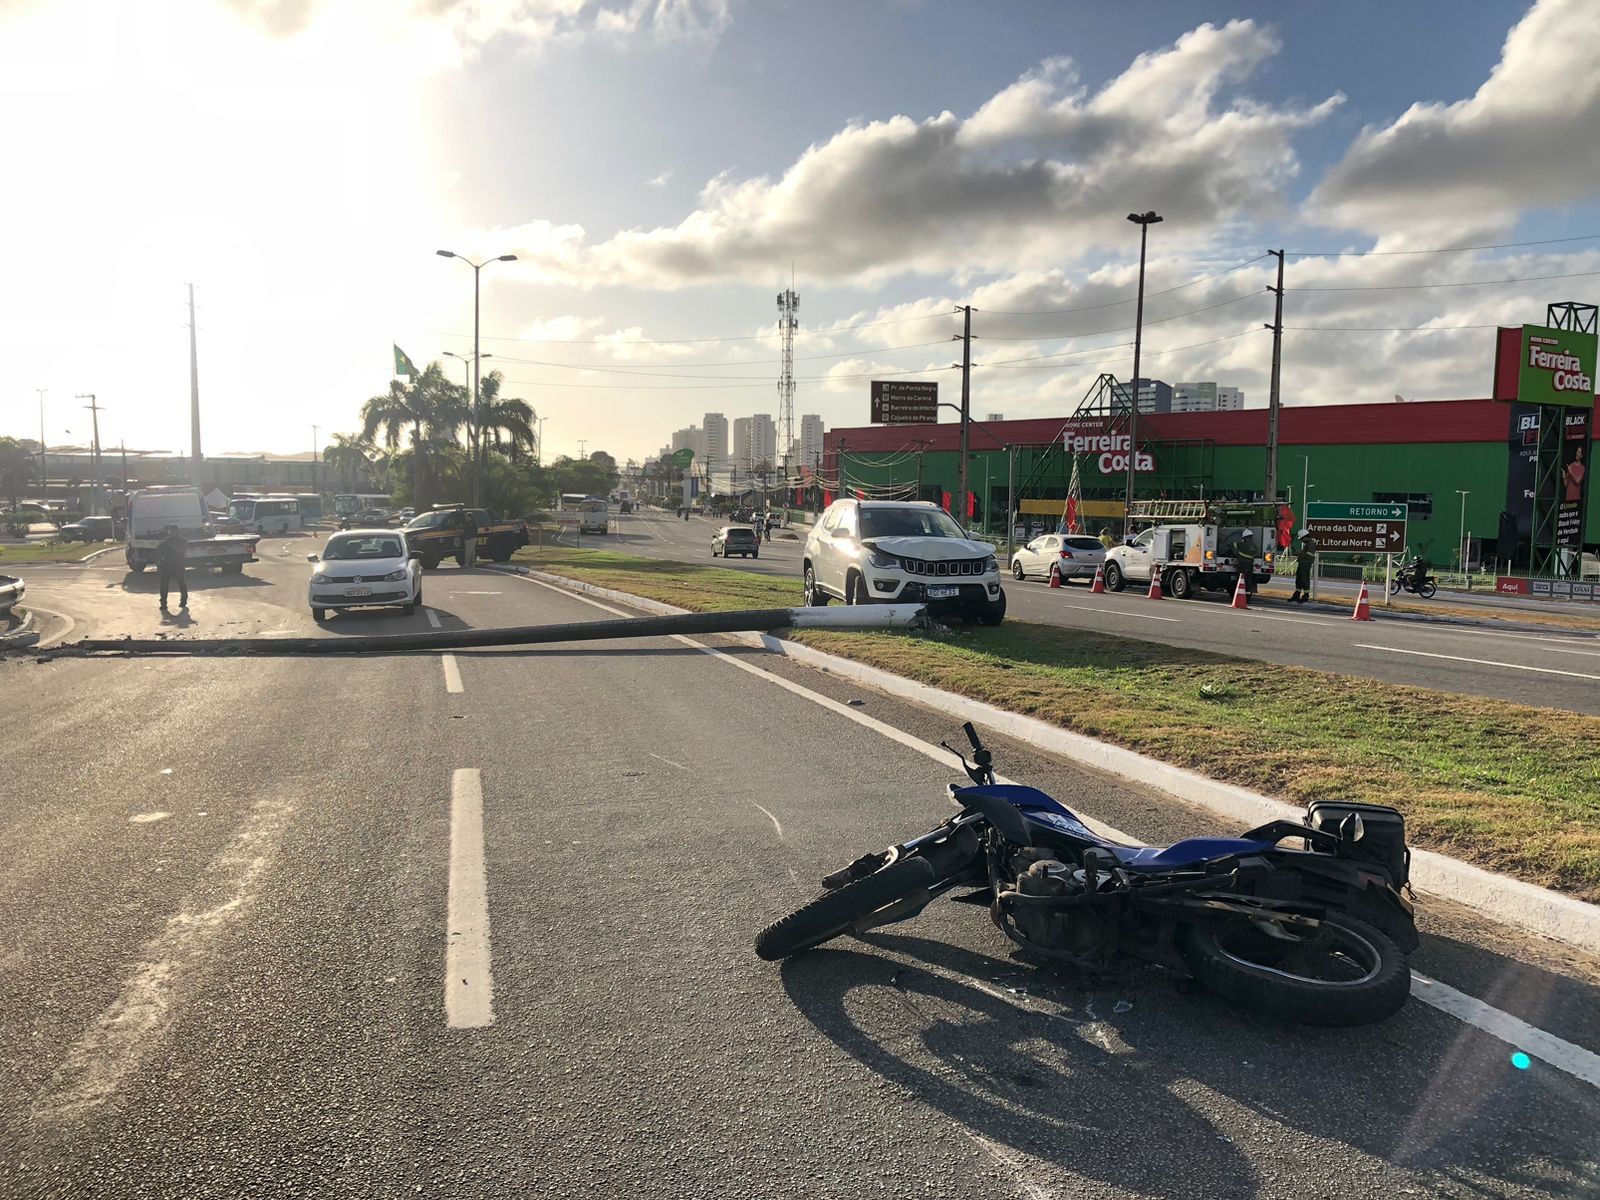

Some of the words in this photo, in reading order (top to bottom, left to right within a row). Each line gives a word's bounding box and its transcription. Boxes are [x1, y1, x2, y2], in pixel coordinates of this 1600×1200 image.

[1529, 345, 1580, 371] Ferreira
[1553, 371, 1591, 391] Costa
[1566, 416, 1585, 425] BLACK
[1063, 430, 1131, 451] Ferreira
[1099, 451, 1153, 473] Costa
[1349, 507, 1388, 516] RETORNO
[1307, 524, 1332, 532] Arena
[1332, 524, 1347, 532] das
[1347, 524, 1373, 533] Dunas
[1322, 538, 1349, 547] Litoral
[1349, 539, 1373, 547] Norte
[1502, 583, 1518, 591] Aqui
